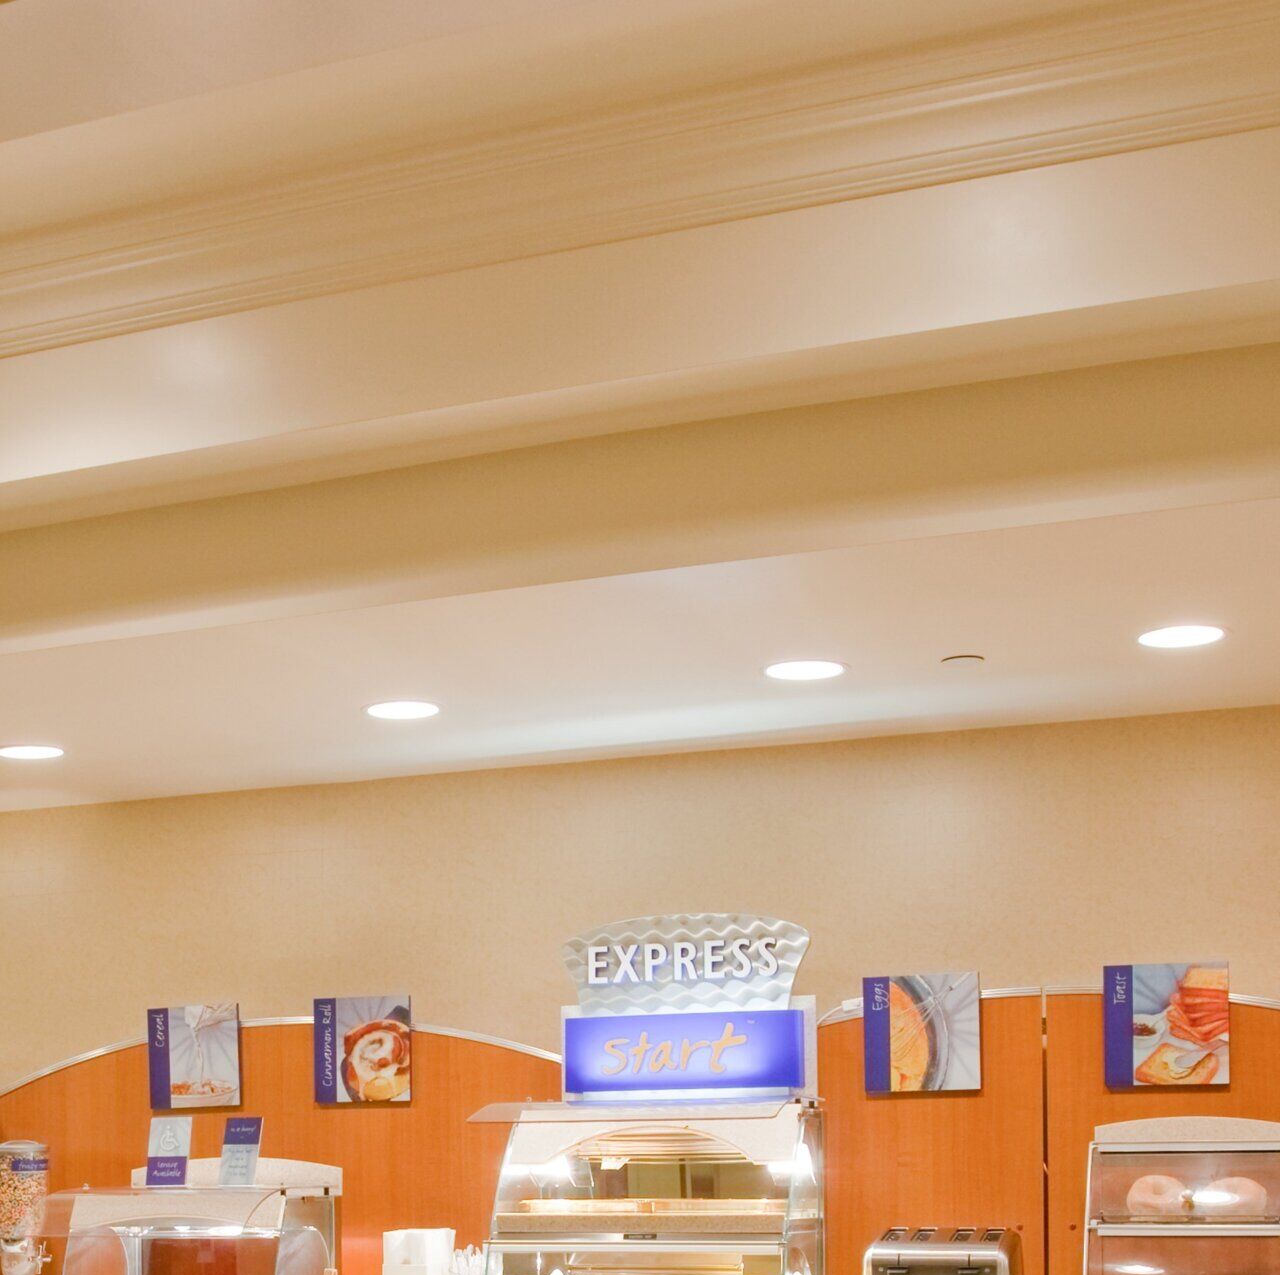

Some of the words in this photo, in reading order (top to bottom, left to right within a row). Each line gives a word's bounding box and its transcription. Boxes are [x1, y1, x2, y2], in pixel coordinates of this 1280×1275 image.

[587, 937, 779, 985] EXPRESS
[872, 983, 890, 1011] Eggs
[1113, 972, 1127, 1005] Toast
[151, 1014, 165, 1048] Cereal
[318, 1004, 333, 1025] Roll
[322, 1027, 333, 1087] Cinnamon
